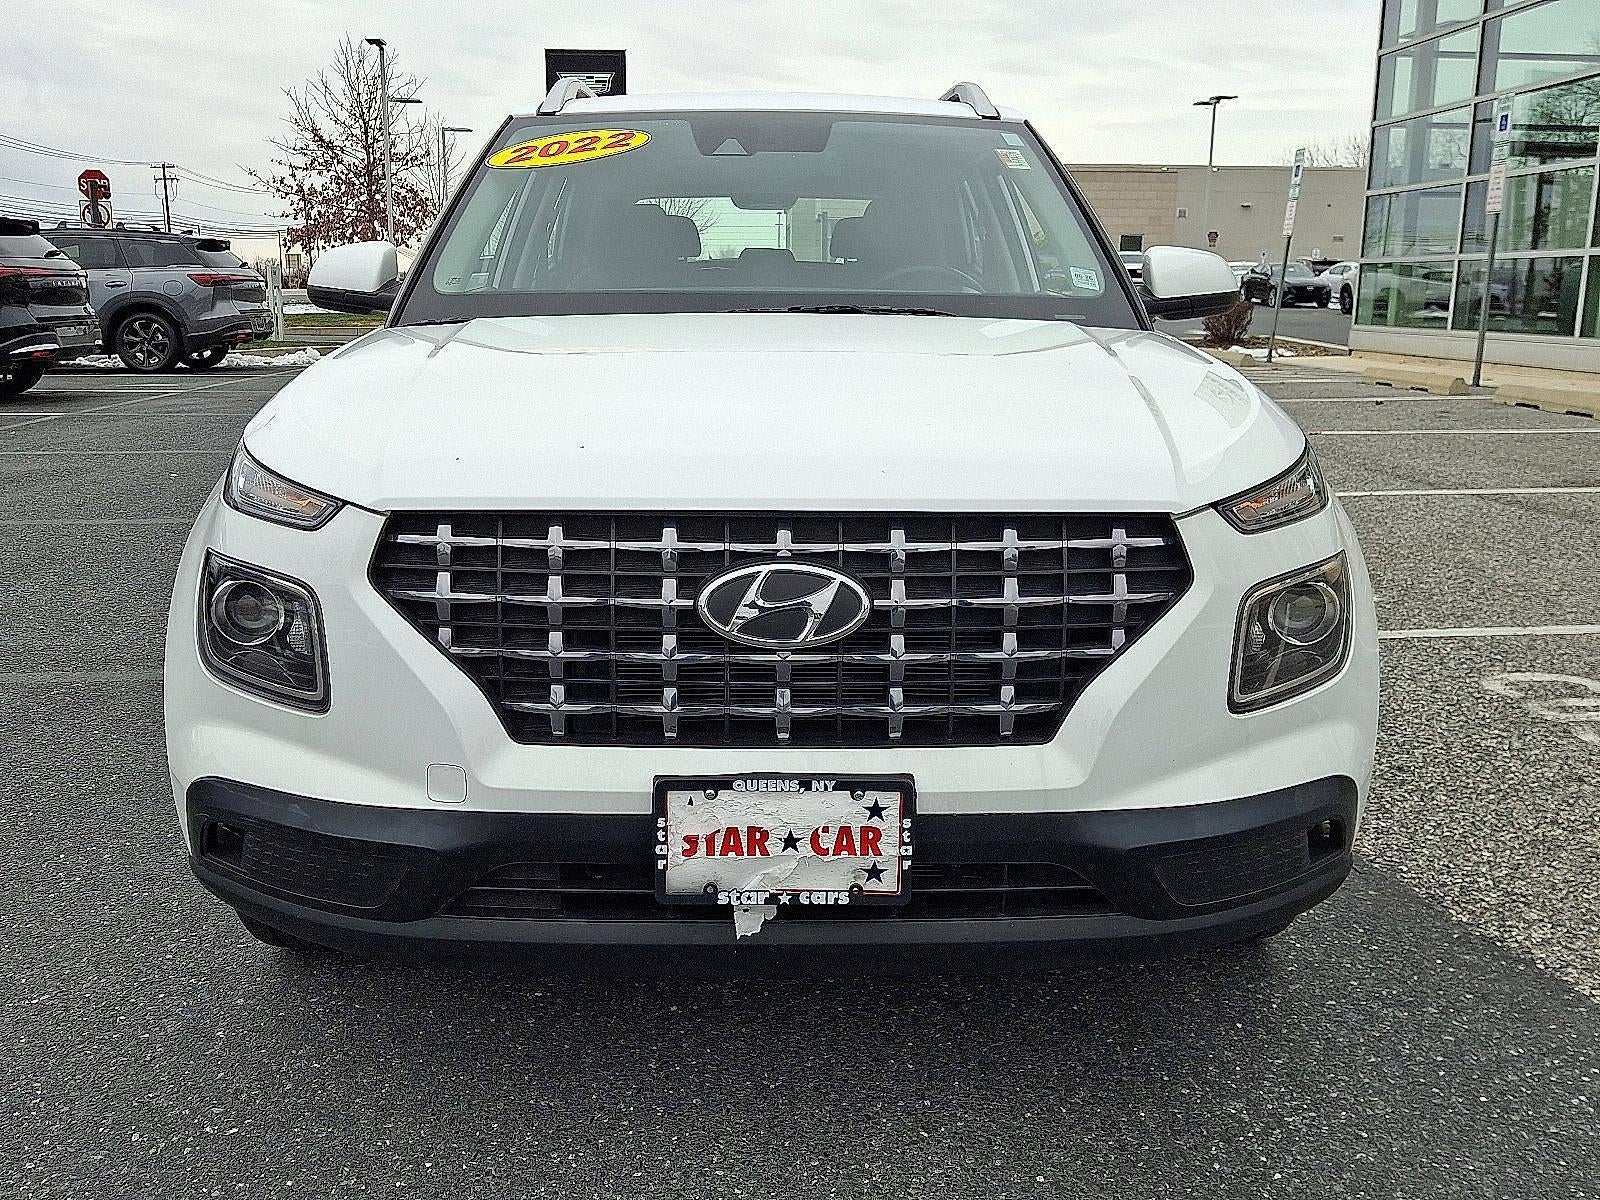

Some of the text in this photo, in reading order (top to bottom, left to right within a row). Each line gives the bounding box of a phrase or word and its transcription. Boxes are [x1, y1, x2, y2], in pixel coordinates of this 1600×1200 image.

[504, 132, 636, 165] 2022
[80, 178, 109, 191] STP
[732, 779, 836, 794] QUEENS, NY
[681, 825, 883, 857] STAR CAR
[717, 888, 850, 905] star cars
